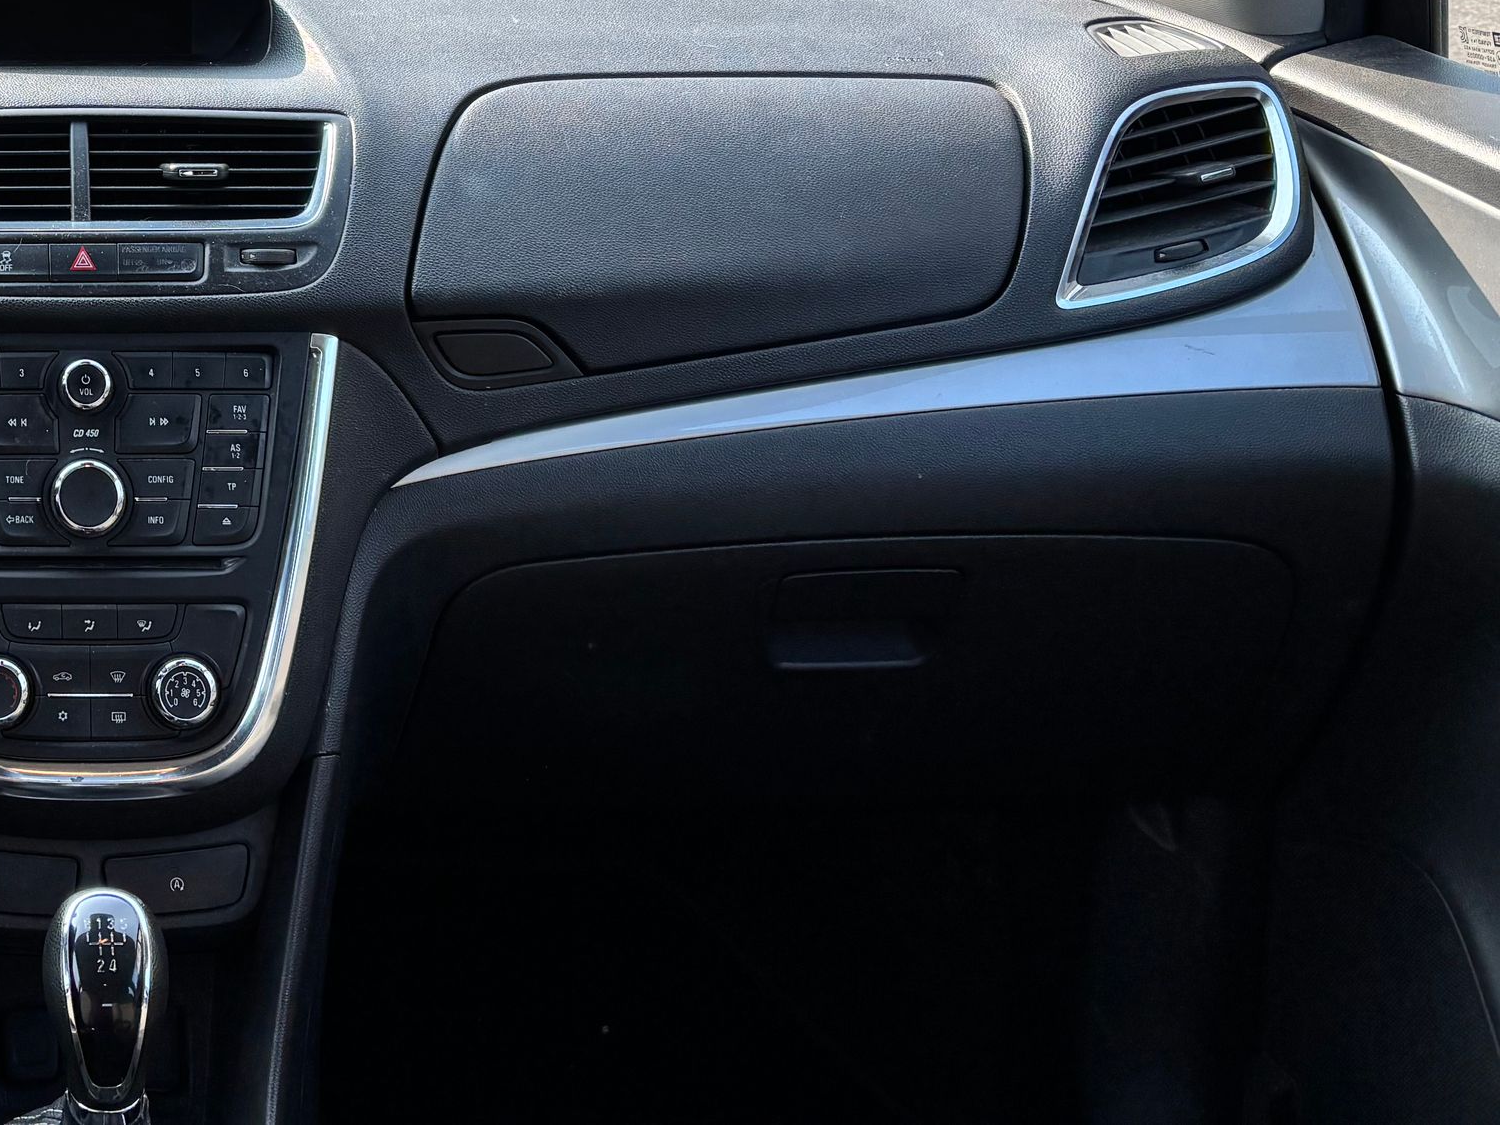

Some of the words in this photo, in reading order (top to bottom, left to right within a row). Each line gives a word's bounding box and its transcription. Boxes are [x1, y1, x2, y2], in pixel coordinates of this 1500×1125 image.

[0, 264, 13, 272] OFF
[19, 368, 25, 377] 3
[148, 368, 154, 377] 4
[195, 368, 201, 377] 5
[243, 368, 249, 377] 6
[79, 387, 93, 396] VOL
[233, 405, 247, 413] FAV
[73, 428, 84, 438] CD
[85, 428, 100, 438] 450
[230, 443, 241, 452] AS
[5, 476, 24, 484] TONE
[147, 475, 174, 484] CONFIG
[227, 482, 237, 491] TP
[15, 516, 34, 524] BACK
[147, 516, 164, 525] INFO
[174, 680, 179, 688] 2
[182, 677, 188, 685] 3
[191, 680, 196, 688] 4
[196, 688, 201, 697] 5
[173, 697, 179, 706] 0
[192, 698, 198, 706] 6
[106, 917, 115, 930] 3
[96, 959, 105, 973] 2
[108, 958, 117, 973] 4
